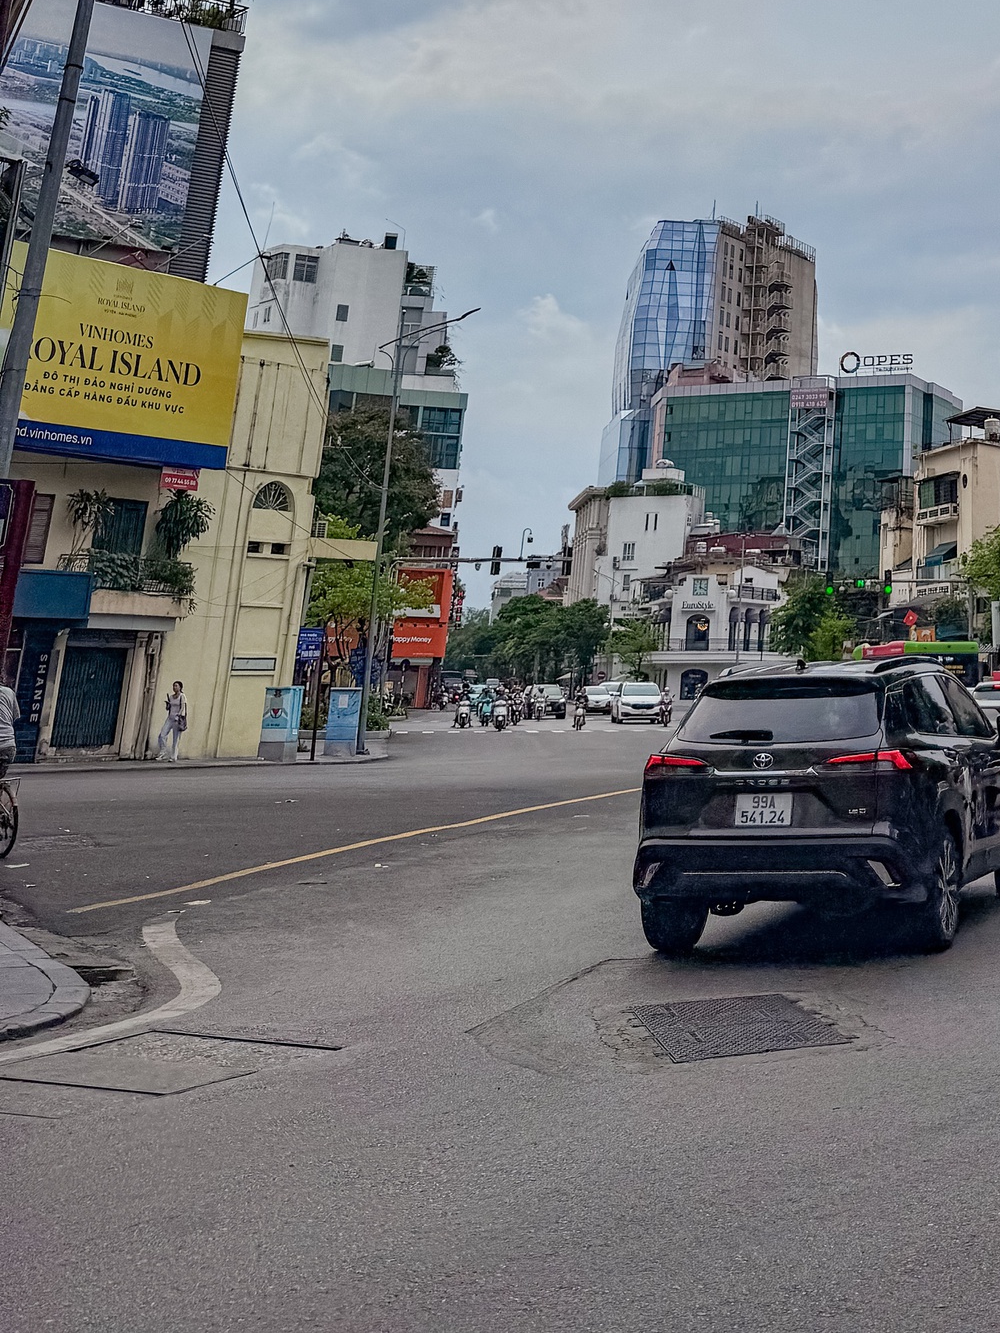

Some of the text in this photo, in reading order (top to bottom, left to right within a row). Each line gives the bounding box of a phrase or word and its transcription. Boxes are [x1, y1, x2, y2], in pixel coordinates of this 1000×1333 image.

[79, 322, 154, 349] VINHOMES
[29, 336, 202, 387] OYAL ISLAND
[863, 353, 913, 367] OPES
[43, 370, 59, 381] ĐÔ
[63, 373, 81, 386] THỊ
[84, 375, 106, 388] ĐẢO
[109, 380, 135, 394] NGHỈ
[59, 385, 81, 398] CẤP
[84, 391, 113, 404] HÀNG
[141, 399, 161, 411] KHU
[165, 402, 185, 415] VỰC
[682, 601, 714, 611] EuroStyle
[29, 654, 49, 723] SHANSE
[752, 795, 776, 809] 99A
[740, 810, 785, 824] 541.24
